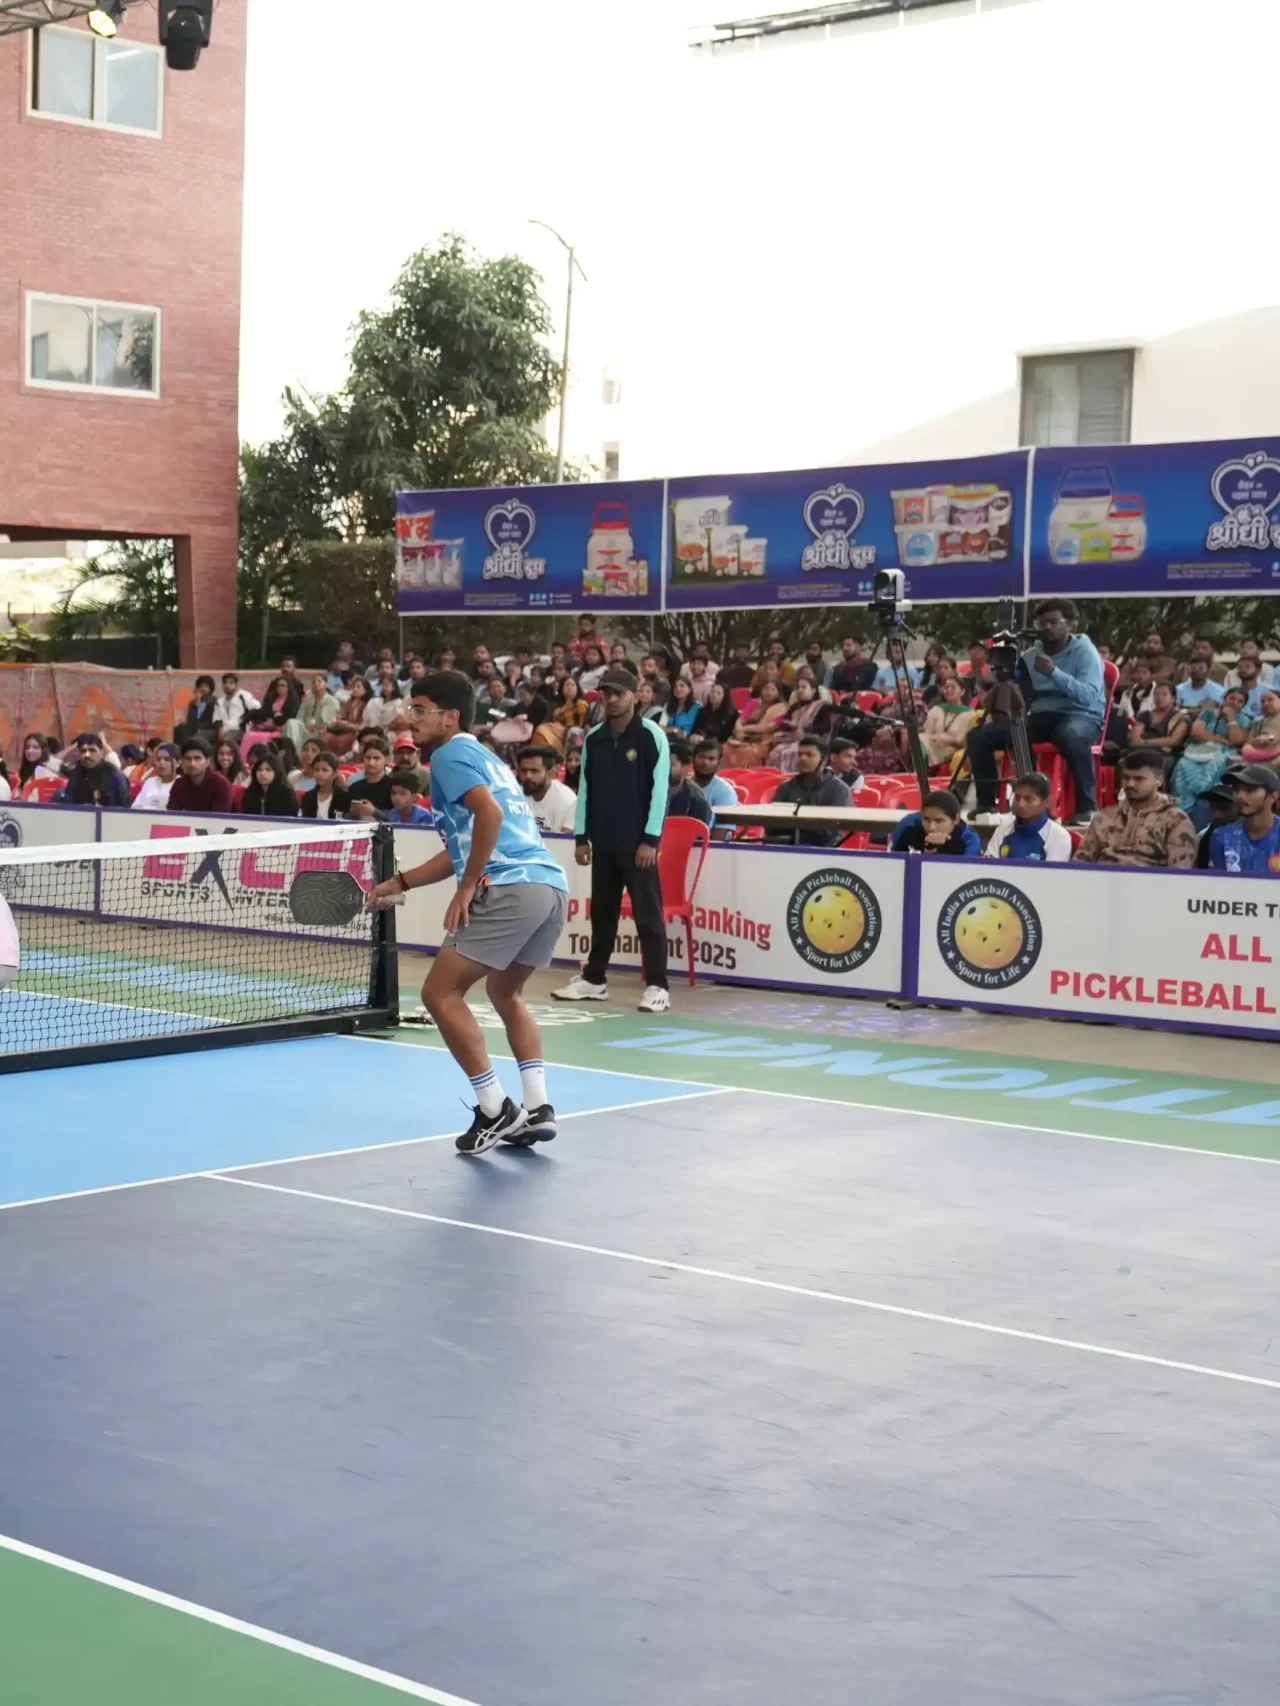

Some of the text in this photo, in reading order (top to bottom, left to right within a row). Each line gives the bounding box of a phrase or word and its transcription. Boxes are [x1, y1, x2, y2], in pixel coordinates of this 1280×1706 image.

[143, 824, 373, 913] EXCEL
[141, 881, 210, 900] SPORTS
[790, 873, 877, 937] All India Pickleball Association
[941, 884, 1037, 951] All India Pickleball Association
[1187, 898, 1280, 918] UNDER T
[569, 933, 736, 970] Tonamnt 2025
[803, 945, 863, 968] Sport for Life
[1200, 933, 1272, 963] ALL
[955, 960, 1021, 984] Sport for Life
[1050, 970, 1276, 1014] PICKLEBALL
